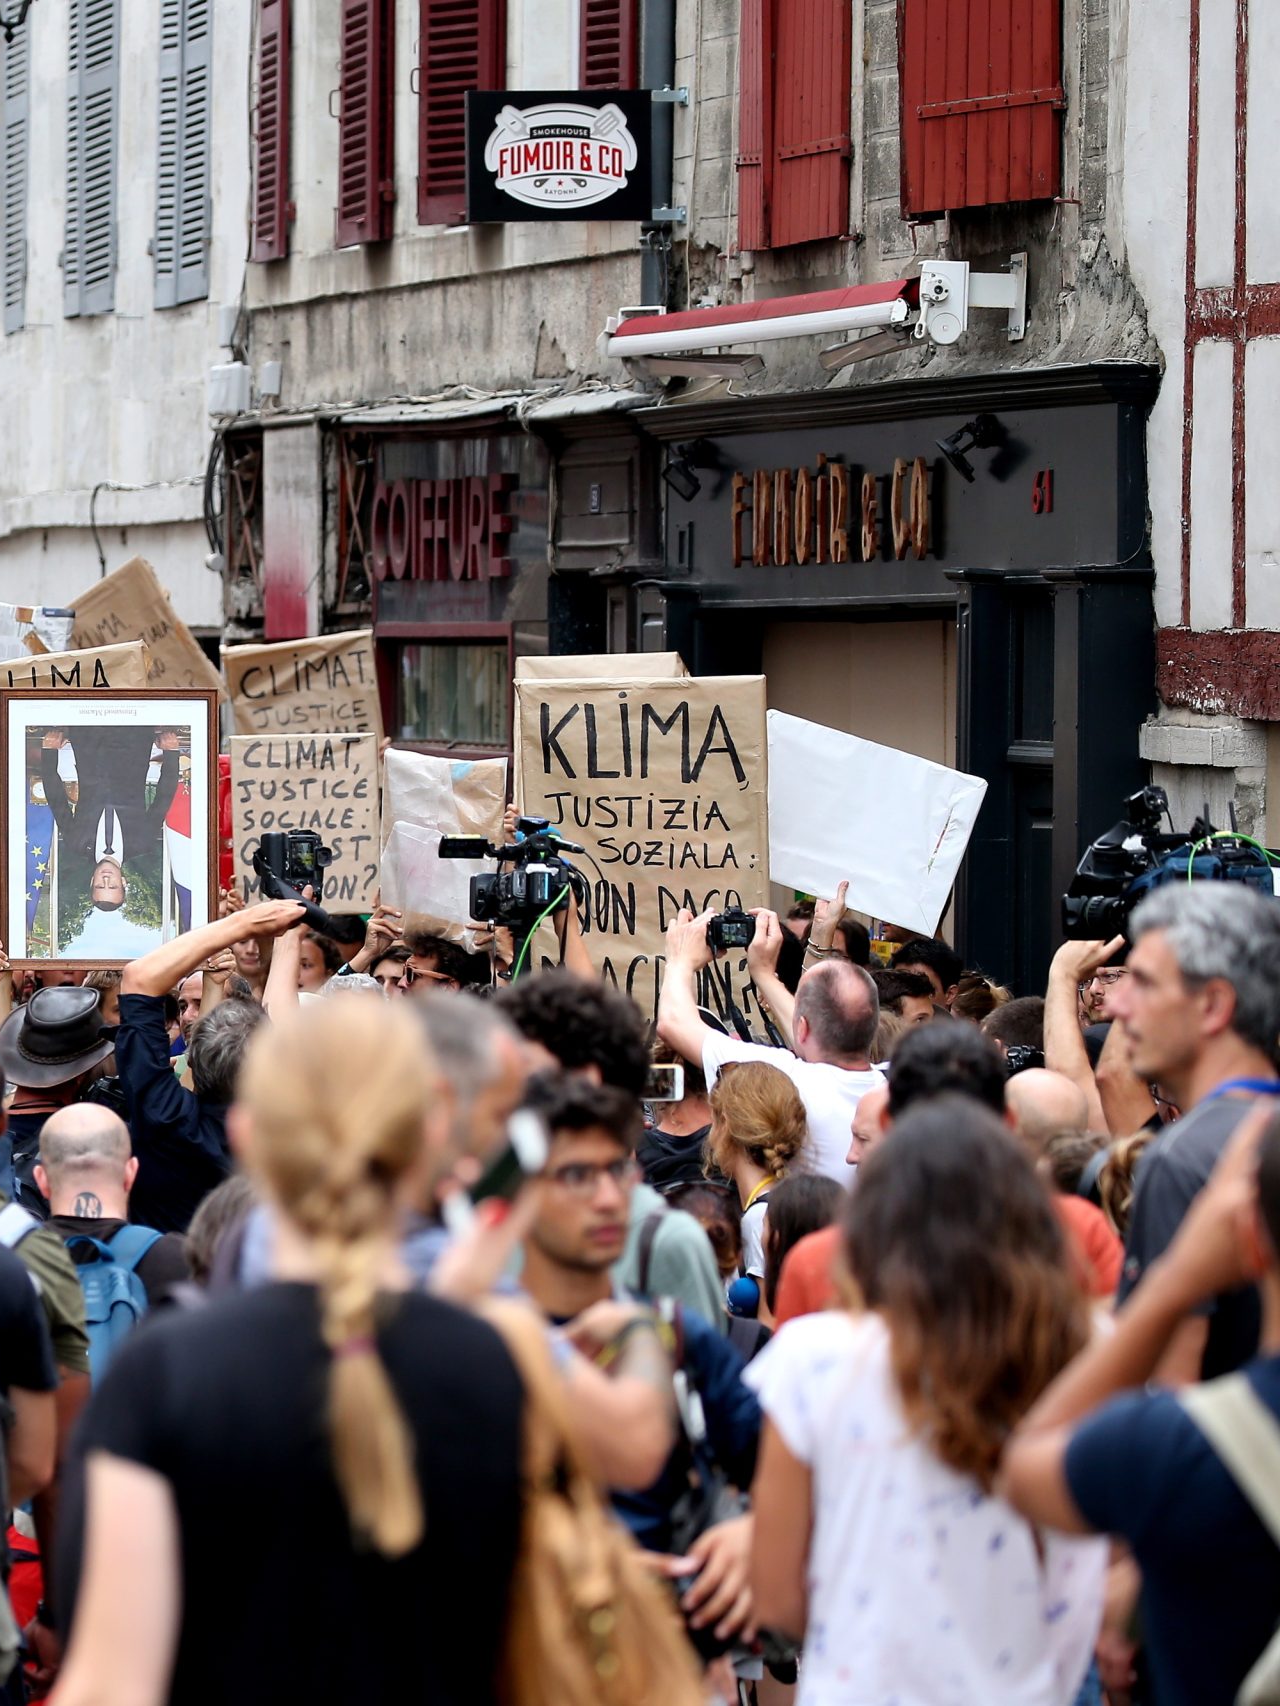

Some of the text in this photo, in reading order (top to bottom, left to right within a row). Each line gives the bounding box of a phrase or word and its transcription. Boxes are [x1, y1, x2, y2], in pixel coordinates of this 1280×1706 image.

[532, 127, 589, 137] SMOKEHOUSE
[498, 141, 623, 179] FUMOIR & CO
[891, 456, 929, 561] CO
[1031, 468, 1054, 514] 61
[371, 474, 513, 581] COIFFURE
[242, 737, 360, 774] CLIMAT,
[237, 777, 368, 803] JUSTICE
[242, 864, 378, 903] MON?
